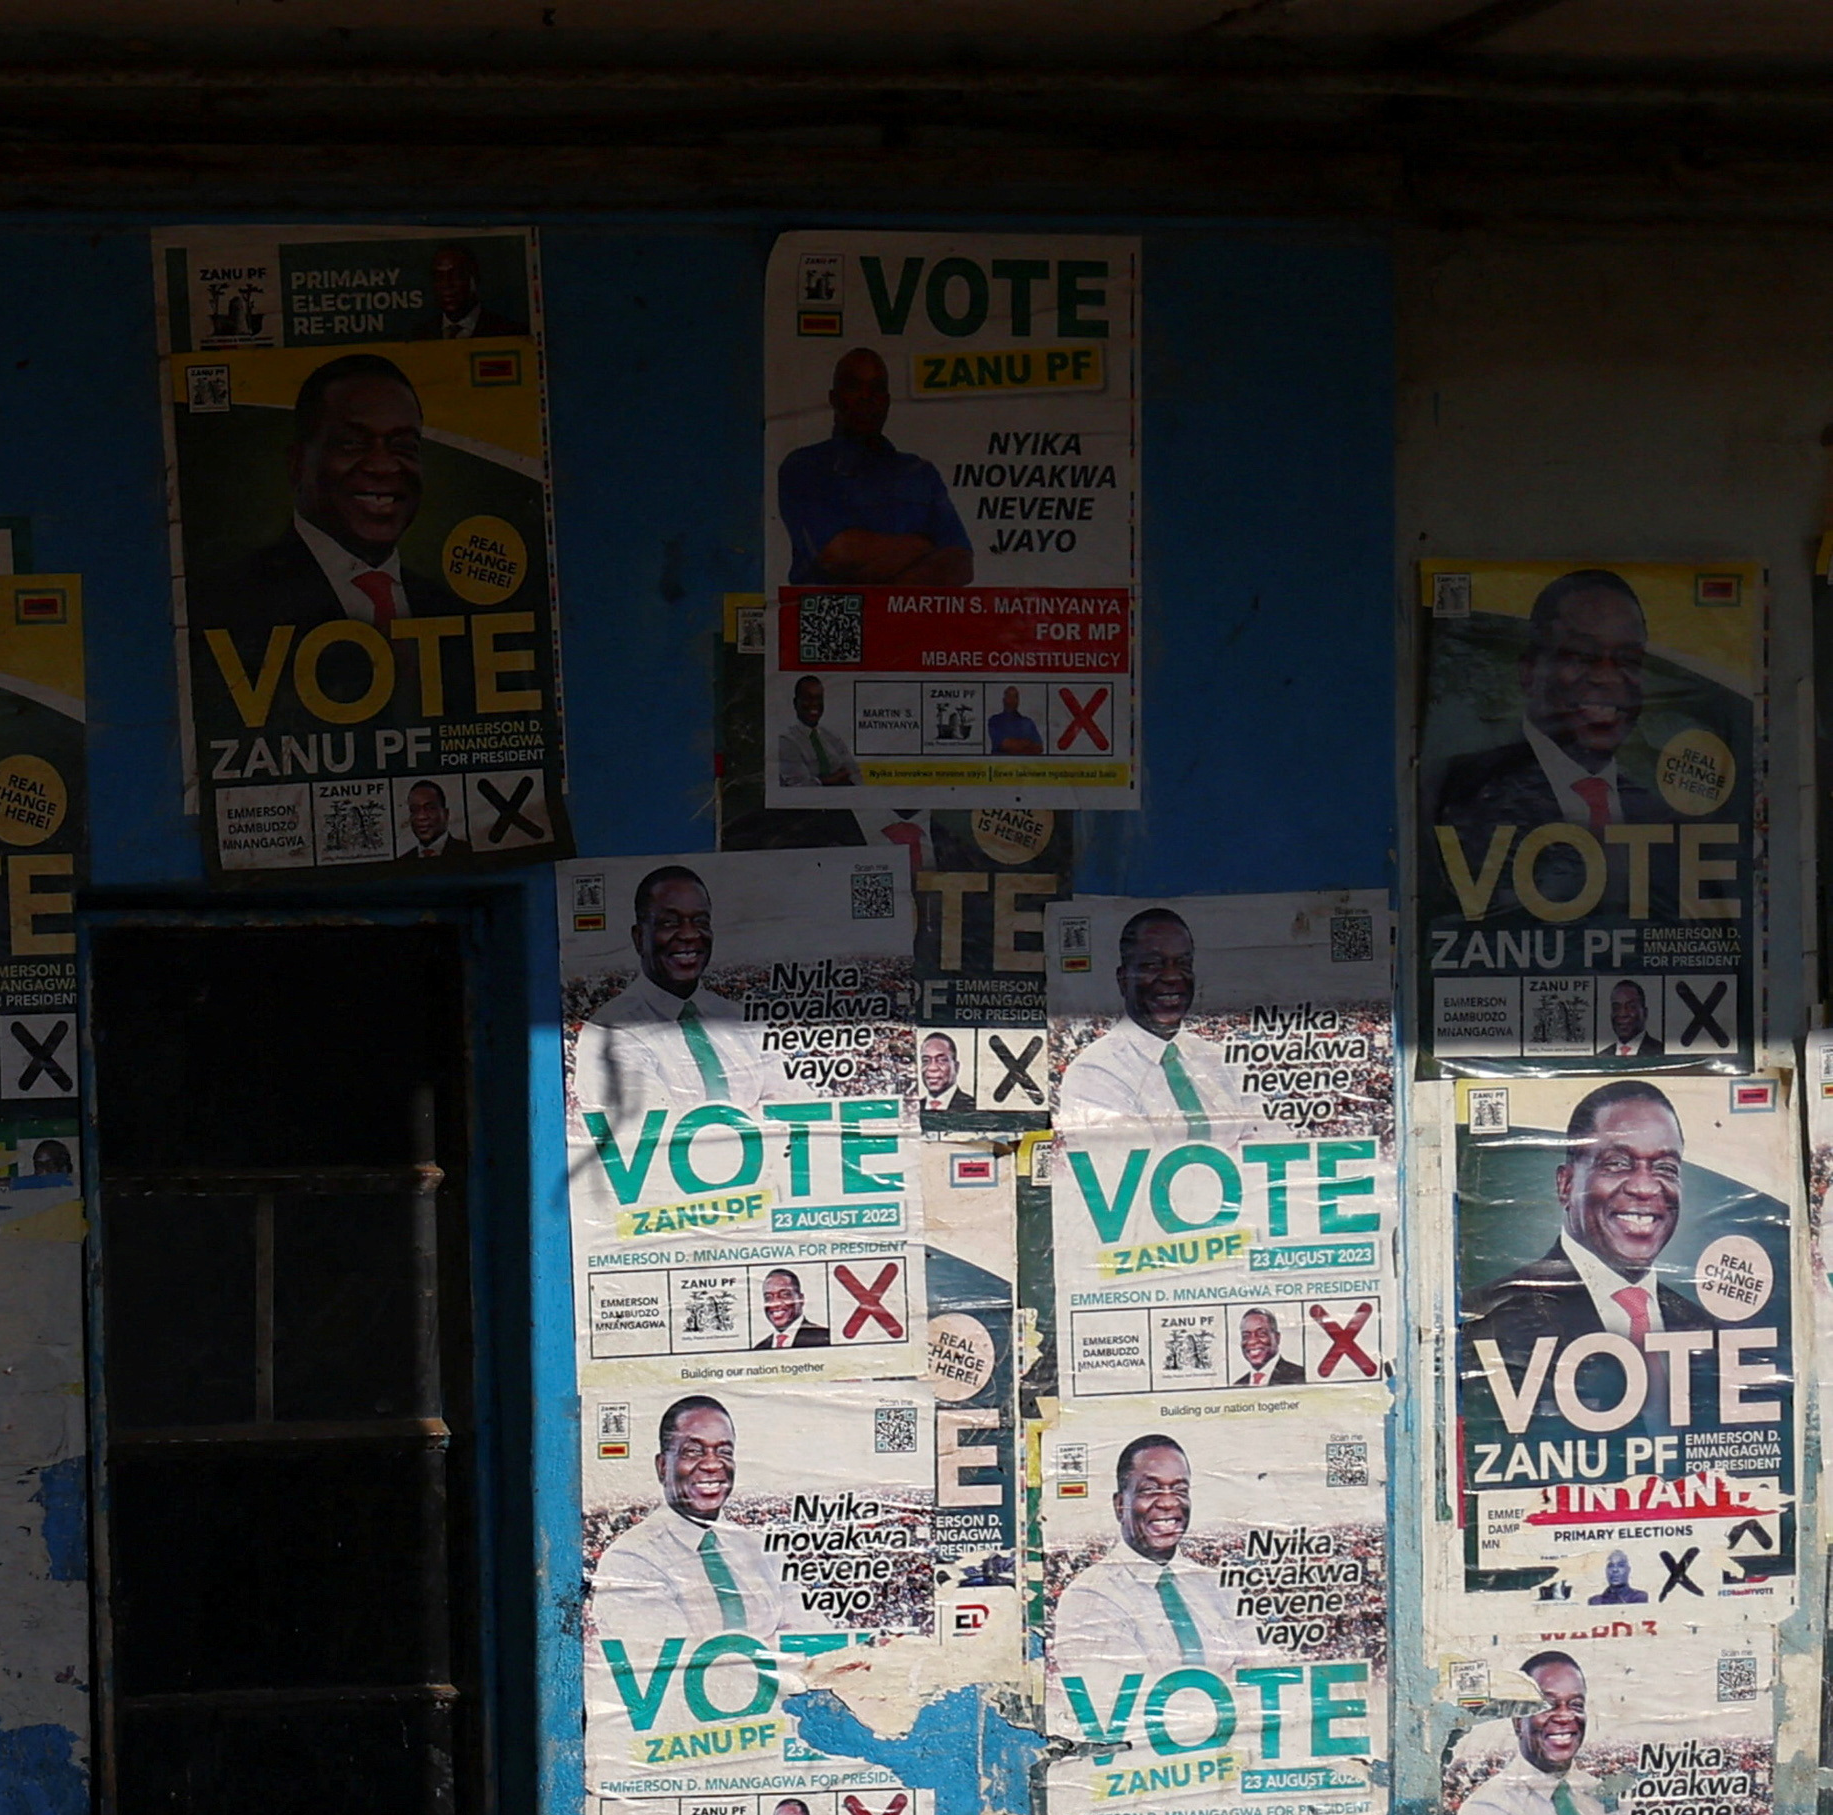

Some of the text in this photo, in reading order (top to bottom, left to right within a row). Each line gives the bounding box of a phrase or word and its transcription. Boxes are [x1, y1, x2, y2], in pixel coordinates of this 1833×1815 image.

[200, 267, 267, 281] ZANU PF
[290, 268, 400, 290] PRIMARY
[292, 290, 424, 313] ELECTIONS
[860, 257, 1109, 338] VOTE
[294, 314, 384, 336] RE-RUN
[923, 351, 1091, 388] ZANU PF
[988, 433, 1082, 456] NYIKA
[953, 464, 1115, 488] INOVAKWA
[977, 497, 1093, 520] NEVENE
[996, 529, 1076, 552] VAYO
[204, 611, 542, 729] VOTE
[210, 727, 432, 780] ZANU PF
[1435, 822, 1741, 923] VOTE
[1431, 929, 1636, 970] ZANU PF
[584, 1100, 905, 1206] VOTE
[1068, 1141, 1380, 1243] VOTE
[1473, 1328, 1780, 1434] VOTE
[1685, 1432, 1780, 1446] EMMERSON D.
[1686, 1445, 1781, 1459] MNANGAGWA
[1474, 1436, 1678, 1484] ZANU PF
[1715, 1458, 1781, 1471] PRESIDENT
[1554, 1525, 1693, 1542] PRIMARY ELECTIONS
[1065, 1665, 1370, 1767] VOTE
[1640, 1743, 1723, 1778] Nyika
